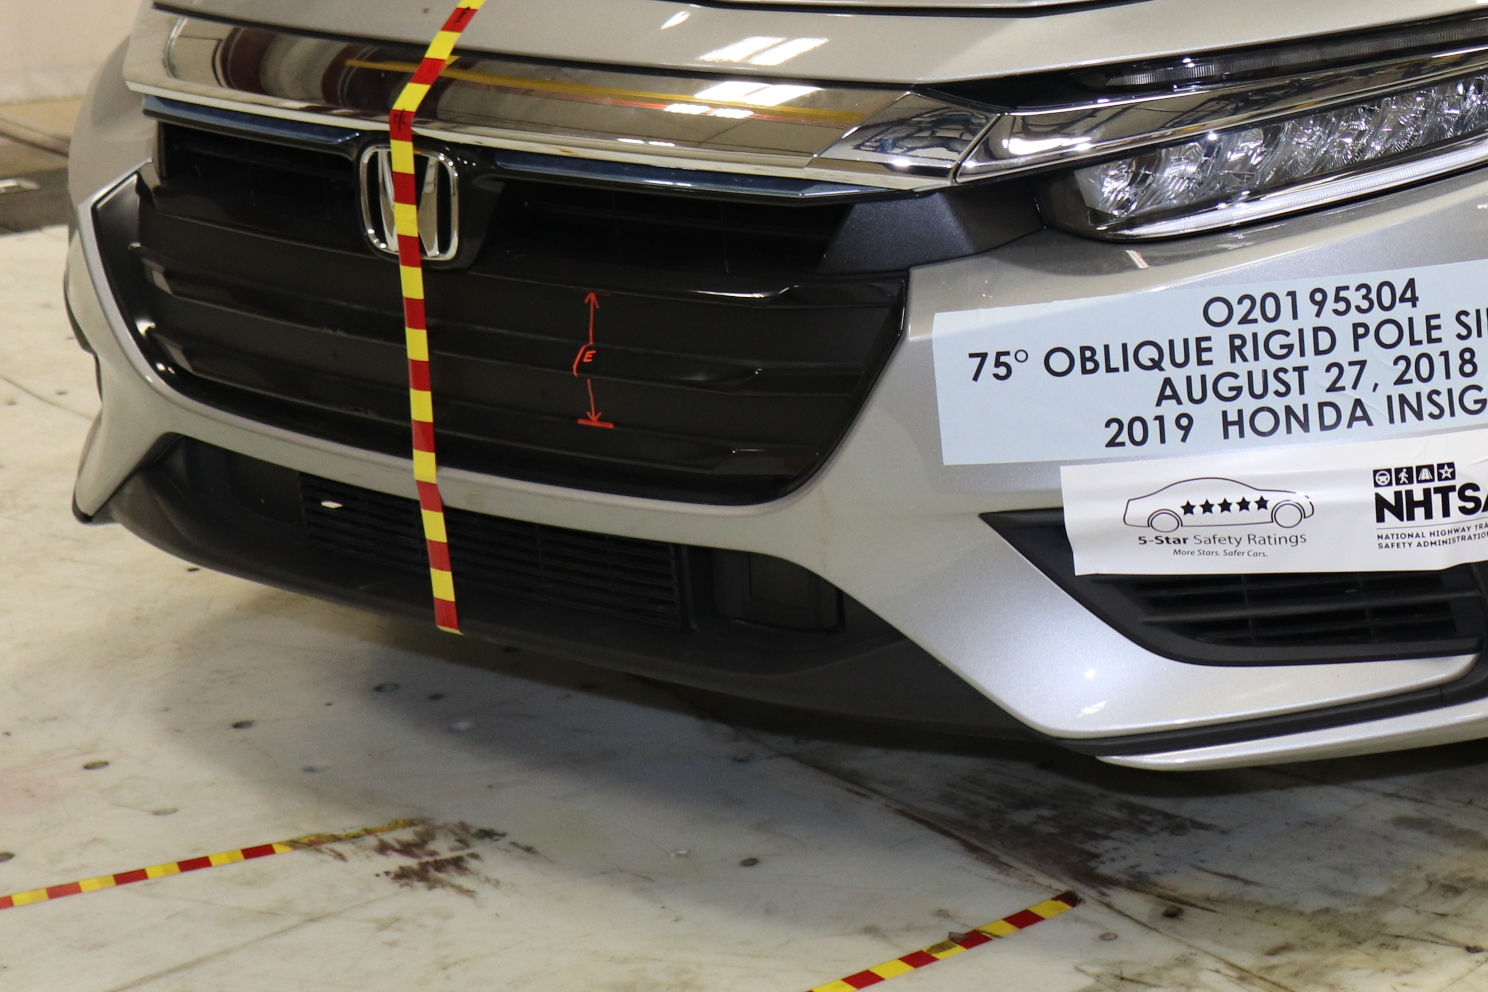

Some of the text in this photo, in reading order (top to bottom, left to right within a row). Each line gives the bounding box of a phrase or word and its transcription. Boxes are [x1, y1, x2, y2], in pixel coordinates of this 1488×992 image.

[968, 348, 1029, 382] 75°
[1043, 336, 1213, 378] OBLIQUE
[1228, 326, 1337, 364] RIGID
[1351, 313, 1443, 352] POLE
[1155, 347, 1478, 407] AUGUST 27, 2018
[1104, 412, 1194, 448] 2019
[1221, 398, 1374, 440] HONDA
[1138, 533, 1307, 547] 5-Star Safety Ratings
[1377, 532, 1426, 541] NATIONAL
[1429, 525, 1472, 538] HIGHWAY
[1173, 548, 1268, 558] More Stars. Safer Cars.
[1377, 541, 1413, 550] SAFETY
